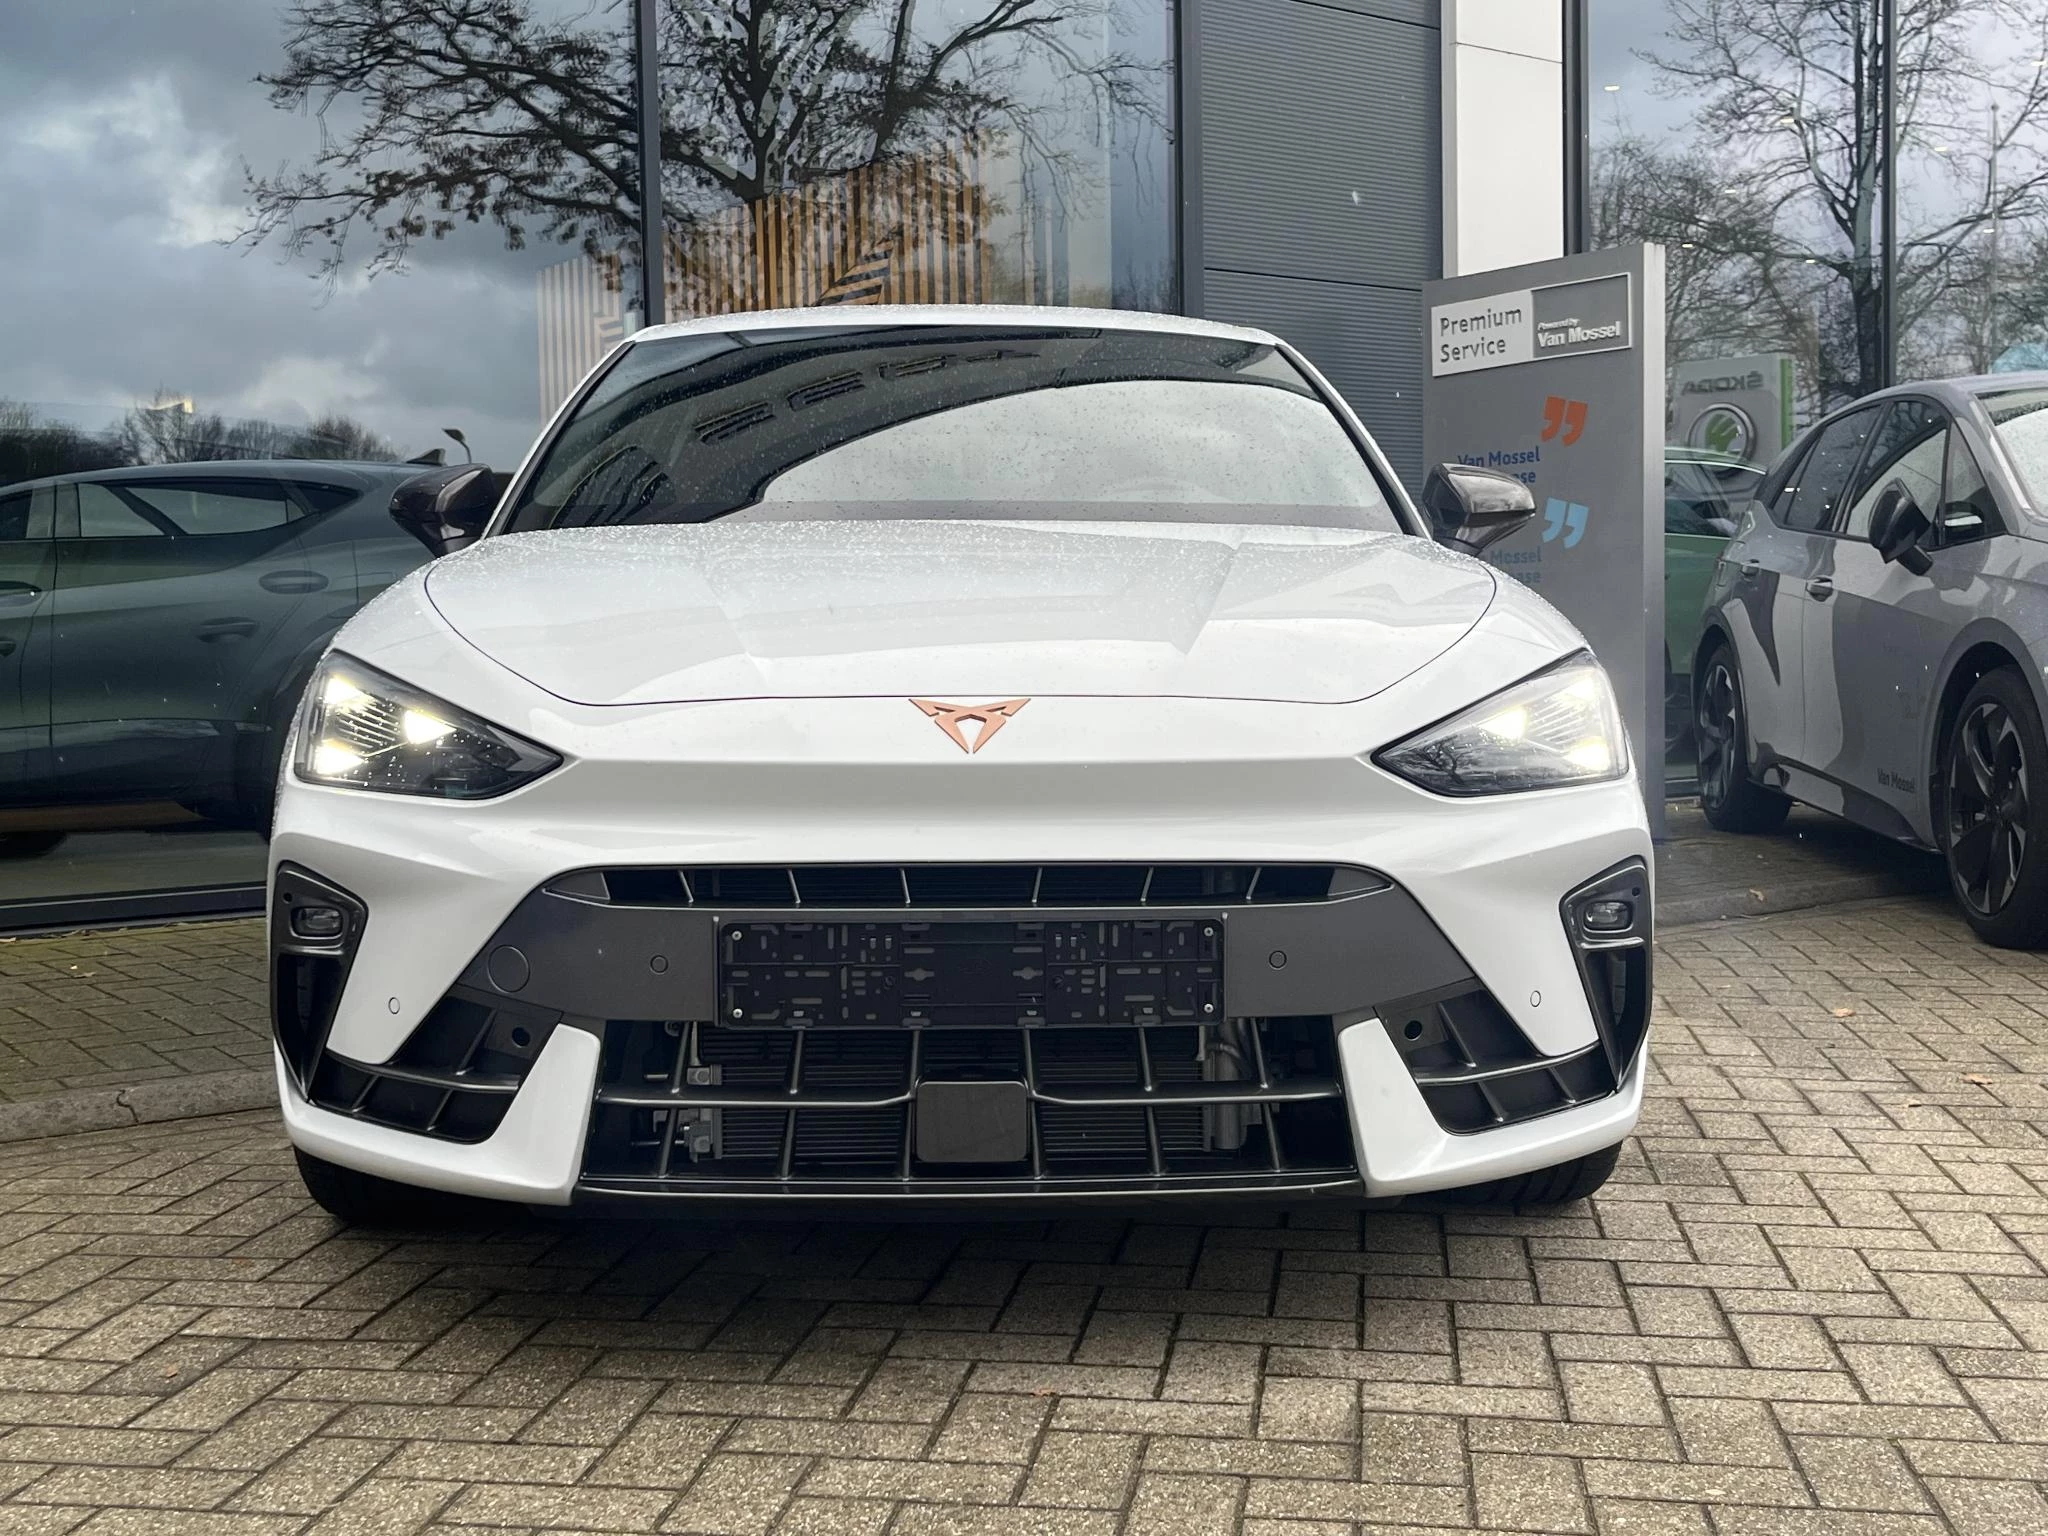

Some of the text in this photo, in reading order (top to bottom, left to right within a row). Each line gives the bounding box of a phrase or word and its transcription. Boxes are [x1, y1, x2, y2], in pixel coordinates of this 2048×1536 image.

[1440, 308, 1522, 337] Premium
[1537, 320, 1621, 347] Van Mossel
[1440, 336, 1506, 363] Service
[1457, 445, 1541, 467] Van Mossel
[1490, 545, 1541, 565] Mossel
